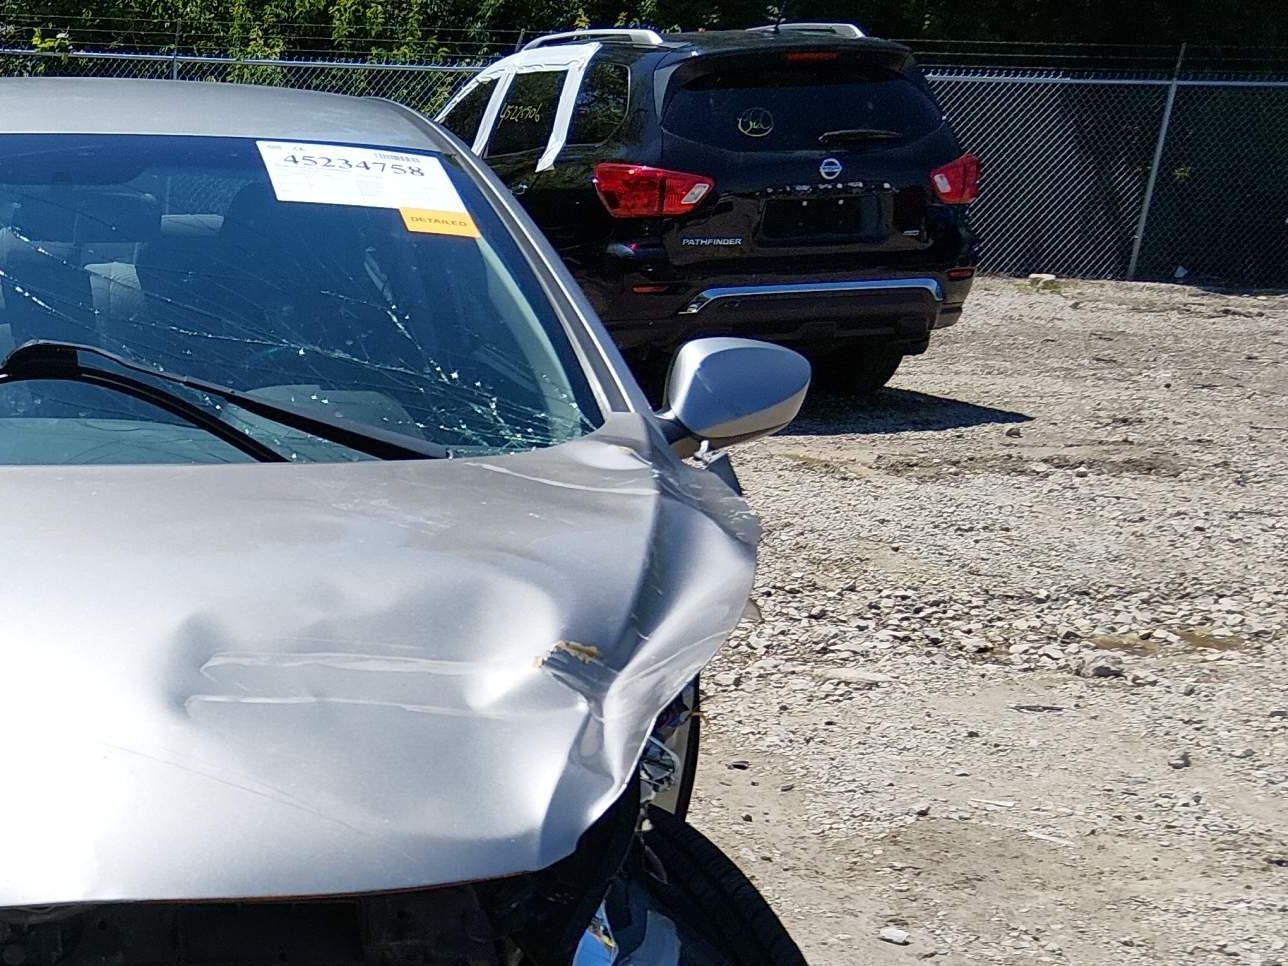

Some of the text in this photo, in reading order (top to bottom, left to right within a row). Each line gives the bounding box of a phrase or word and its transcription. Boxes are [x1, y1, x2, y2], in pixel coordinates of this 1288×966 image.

[282, 153, 426, 177] 45234758
[409, 216, 468, 228] DETAILED
[681, 238, 743, 246] PATHFINDER
